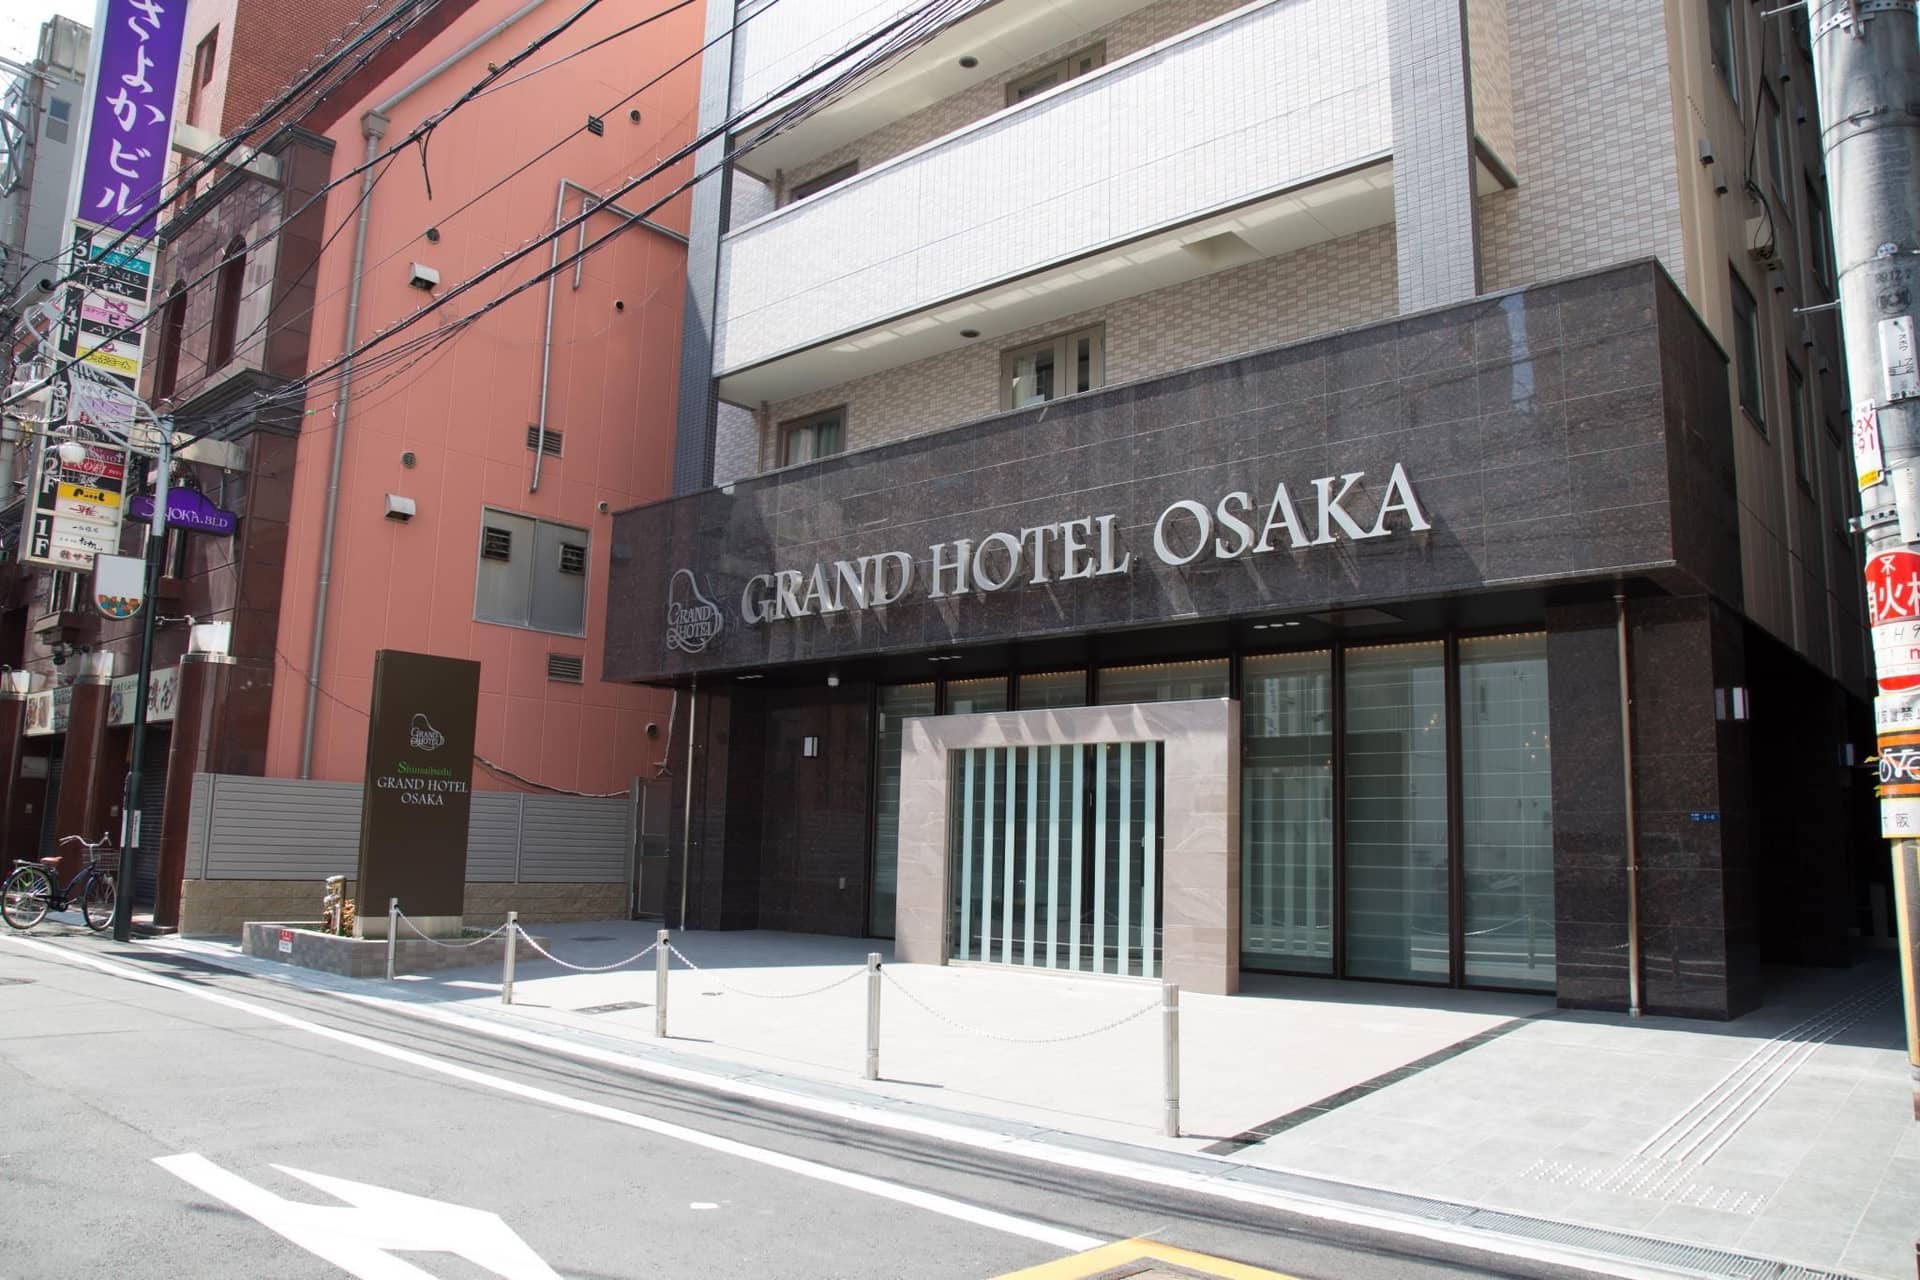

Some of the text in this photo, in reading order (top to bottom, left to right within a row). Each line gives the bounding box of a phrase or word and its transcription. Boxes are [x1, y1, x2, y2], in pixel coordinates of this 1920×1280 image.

[33, 519, 49, 556] 1F
[742, 463, 1431, 625] GRAND HOTEL OSAKA
[668, 603, 711, 625] GRAND
[677, 621, 713, 640] HOTEL
[377, 776, 468, 793] GRAND HOTEL
[401, 792, 444, 806] OSAKA
